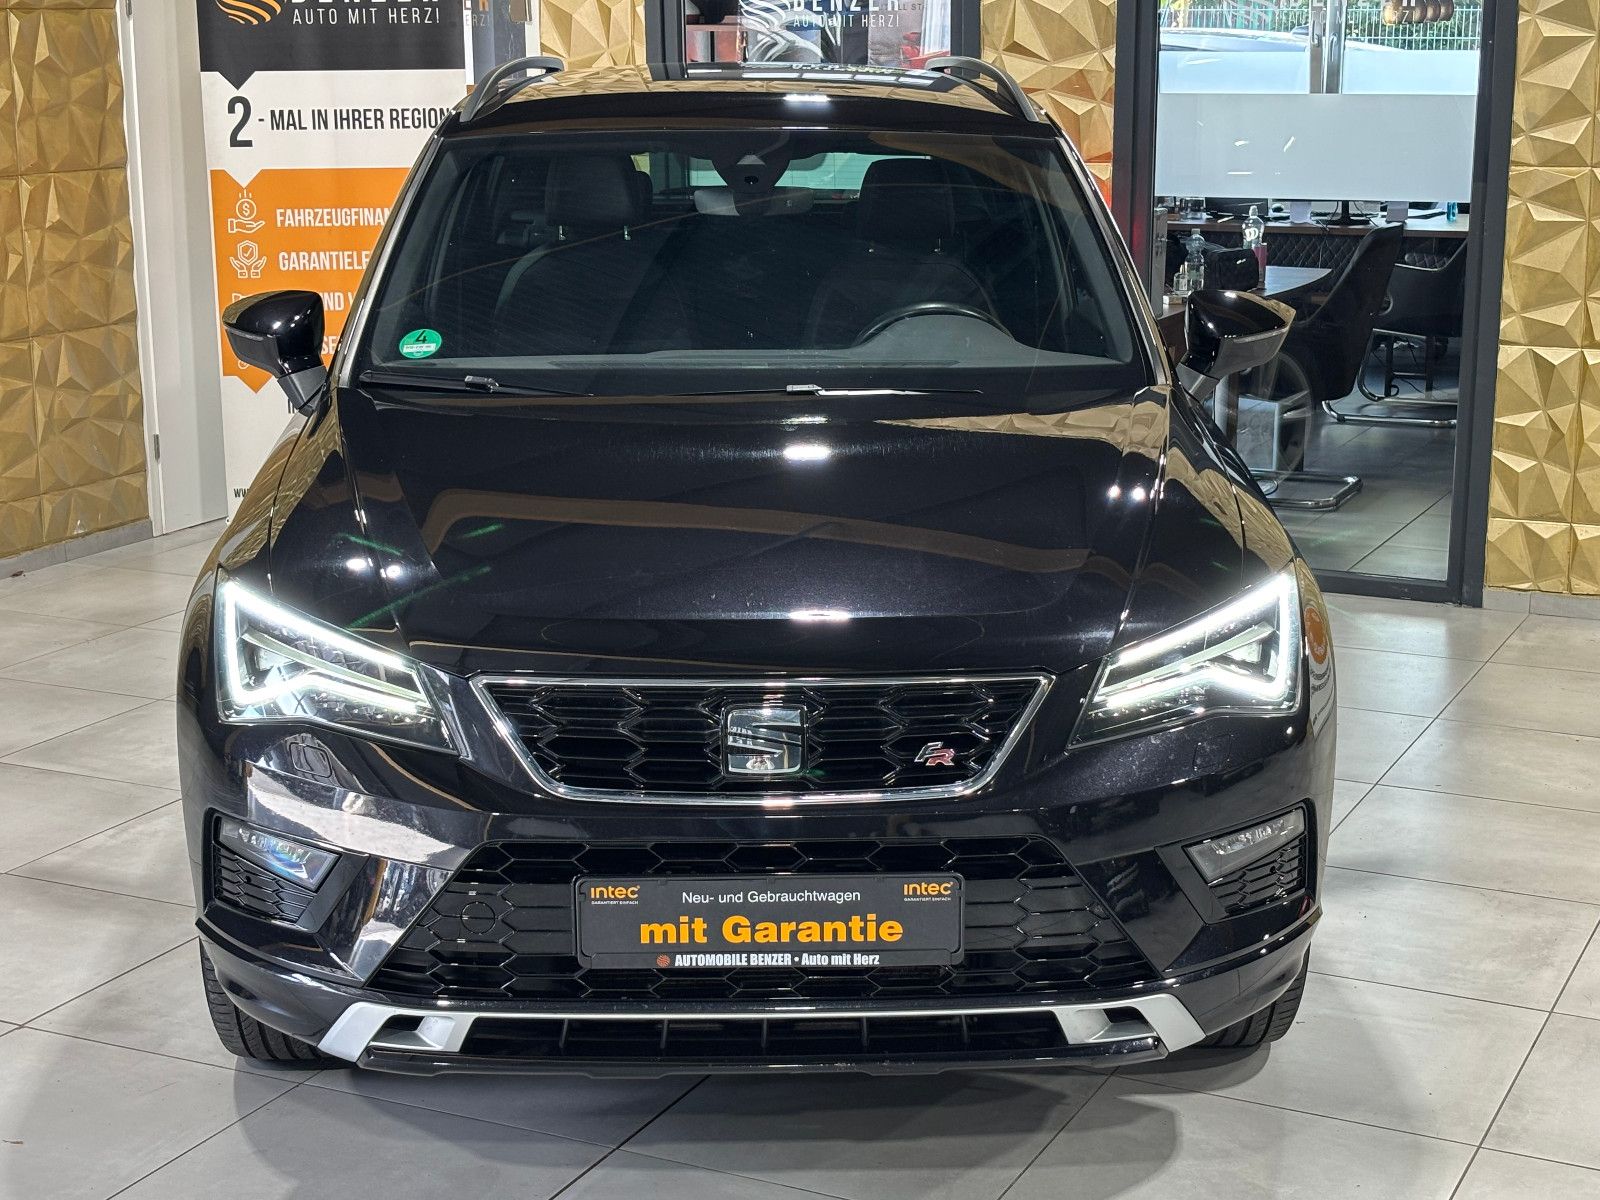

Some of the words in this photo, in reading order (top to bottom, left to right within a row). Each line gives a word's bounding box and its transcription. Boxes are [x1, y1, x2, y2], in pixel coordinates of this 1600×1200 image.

[292, 9, 338, 25] AUTO
[348, 8, 377, 24] MIT
[388, 8, 440, 24] HERZ!
[793, 15, 826, 28] AUTO
[227, 96, 253, 148] 2
[270, 109, 308, 131] MAL
[312, 109, 327, 130] IN
[333, 108, 385, 130] IHRER
[415, 330, 428, 344] 4
[914, 741, 955, 767] FR
[590, 885, 640, 899] intec
[903, 881, 953, 896] intec
[682, 891, 715, 904] Neu-
[718, 891, 743, 903] und
[747, 890, 861, 904] Gebrauchtwagen
[640, 916, 707, 944] mit
[721, 913, 903, 943] Garantie
[674, 954, 748, 967] AUTOMOBILE
[750, 953, 792, 966] BENZER
[801, 953, 829, 966] Auto
[831, 953, 851, 966] mit
[853, 953, 880, 966] Herz
